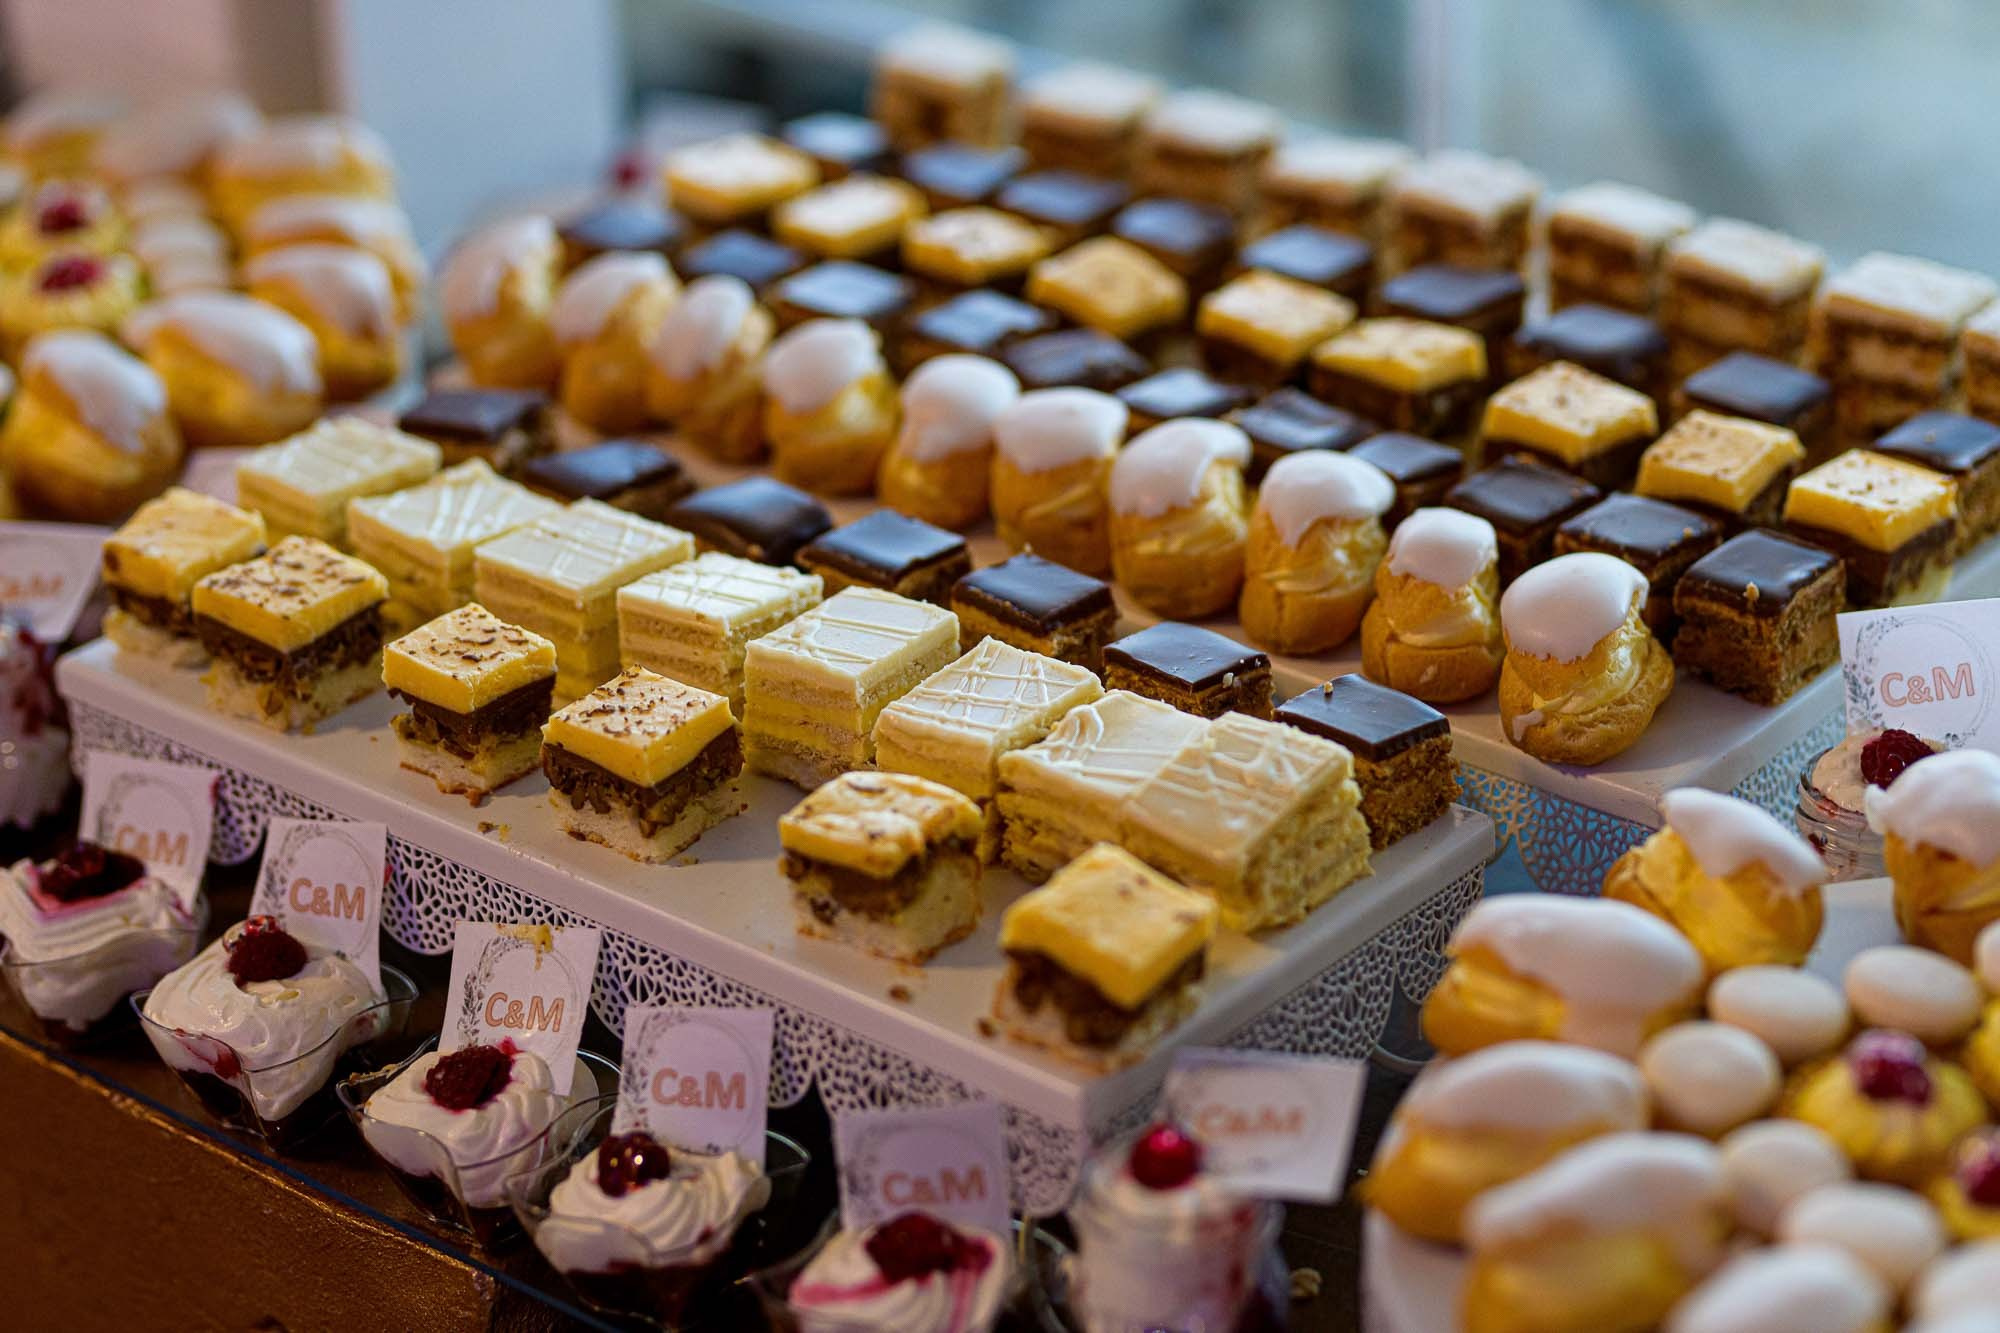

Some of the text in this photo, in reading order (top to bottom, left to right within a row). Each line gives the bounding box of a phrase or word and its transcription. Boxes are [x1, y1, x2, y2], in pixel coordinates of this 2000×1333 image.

[1880, 662, 1975, 708] C&M
[289, 878, 365, 922] C&M
[484, 991, 565, 1033] C&M
[651, 1066, 746, 1111] C&M
[881, 1165, 987, 1206] C&M
